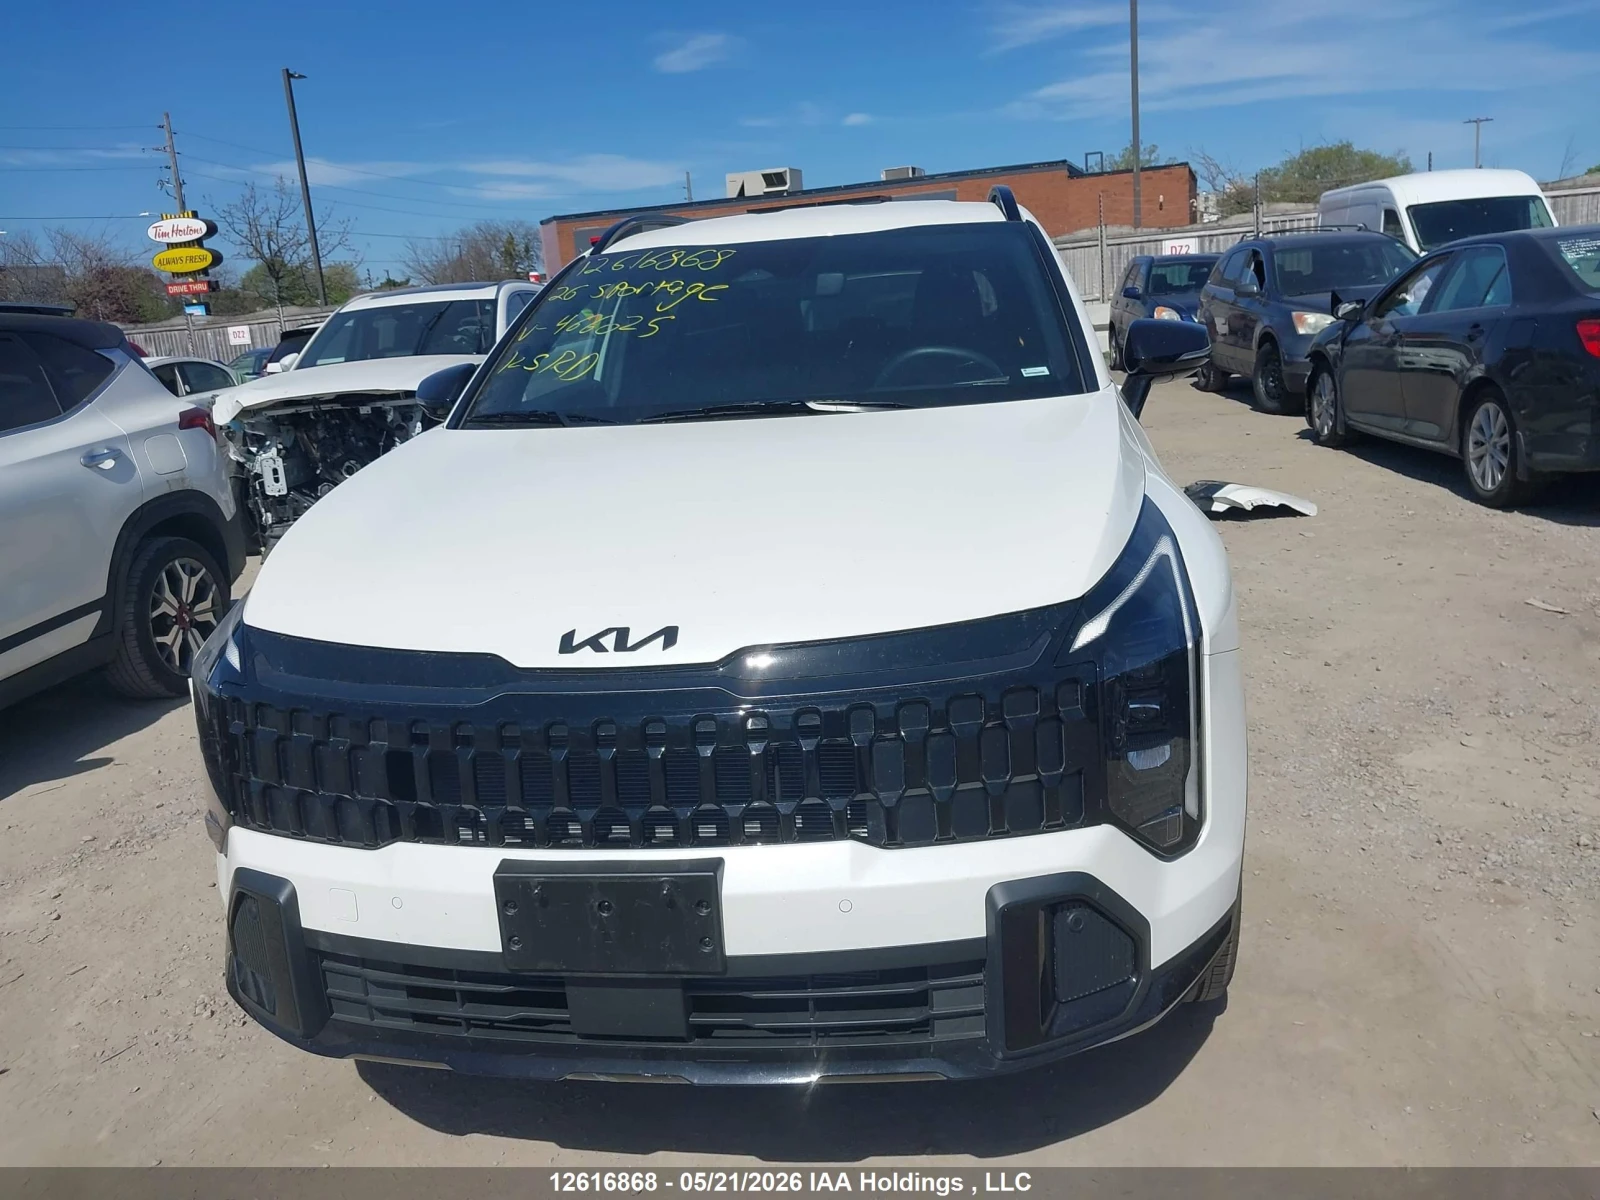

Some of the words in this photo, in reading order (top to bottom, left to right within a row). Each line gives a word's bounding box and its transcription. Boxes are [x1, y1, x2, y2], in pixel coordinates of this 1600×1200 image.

[152, 225, 170, 239] Tim
[171, 223, 203, 238] Hortons
[157, 256, 184, 267] ALWAYS
[185, 254, 208, 264] FRESH
[577, 249, 737, 276] 12616868
[168, 285, 188, 294] DRIVE
[189, 283, 207, 292] THRU
[548, 284, 589, 302] 26
[558, 625, 680, 655] KIA
